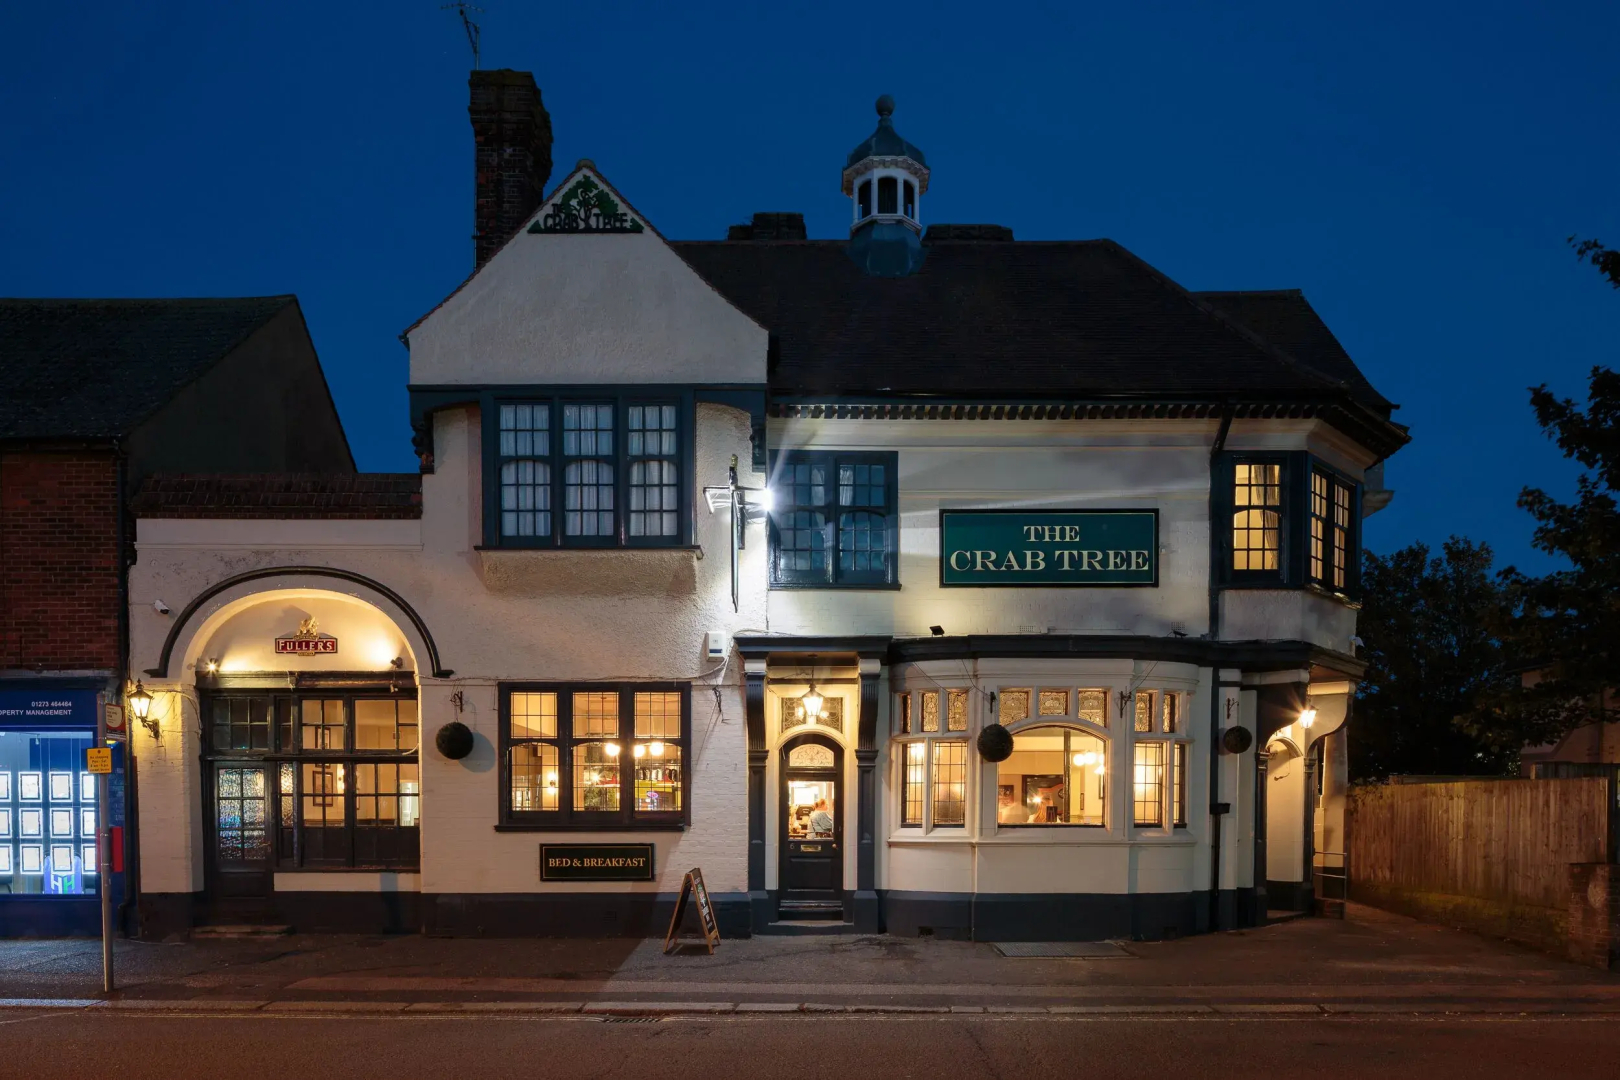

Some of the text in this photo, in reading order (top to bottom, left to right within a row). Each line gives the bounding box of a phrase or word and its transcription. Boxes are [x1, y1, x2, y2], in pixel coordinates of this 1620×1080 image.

[543, 212, 628, 229] CRAB TREE
[1023, 525, 1080, 542] THE
[950, 550, 1149, 572] CRAB TREE
[279, 640, 333, 652] FULLER'S
[549, 857, 645, 867] BED & BREAKFAST
